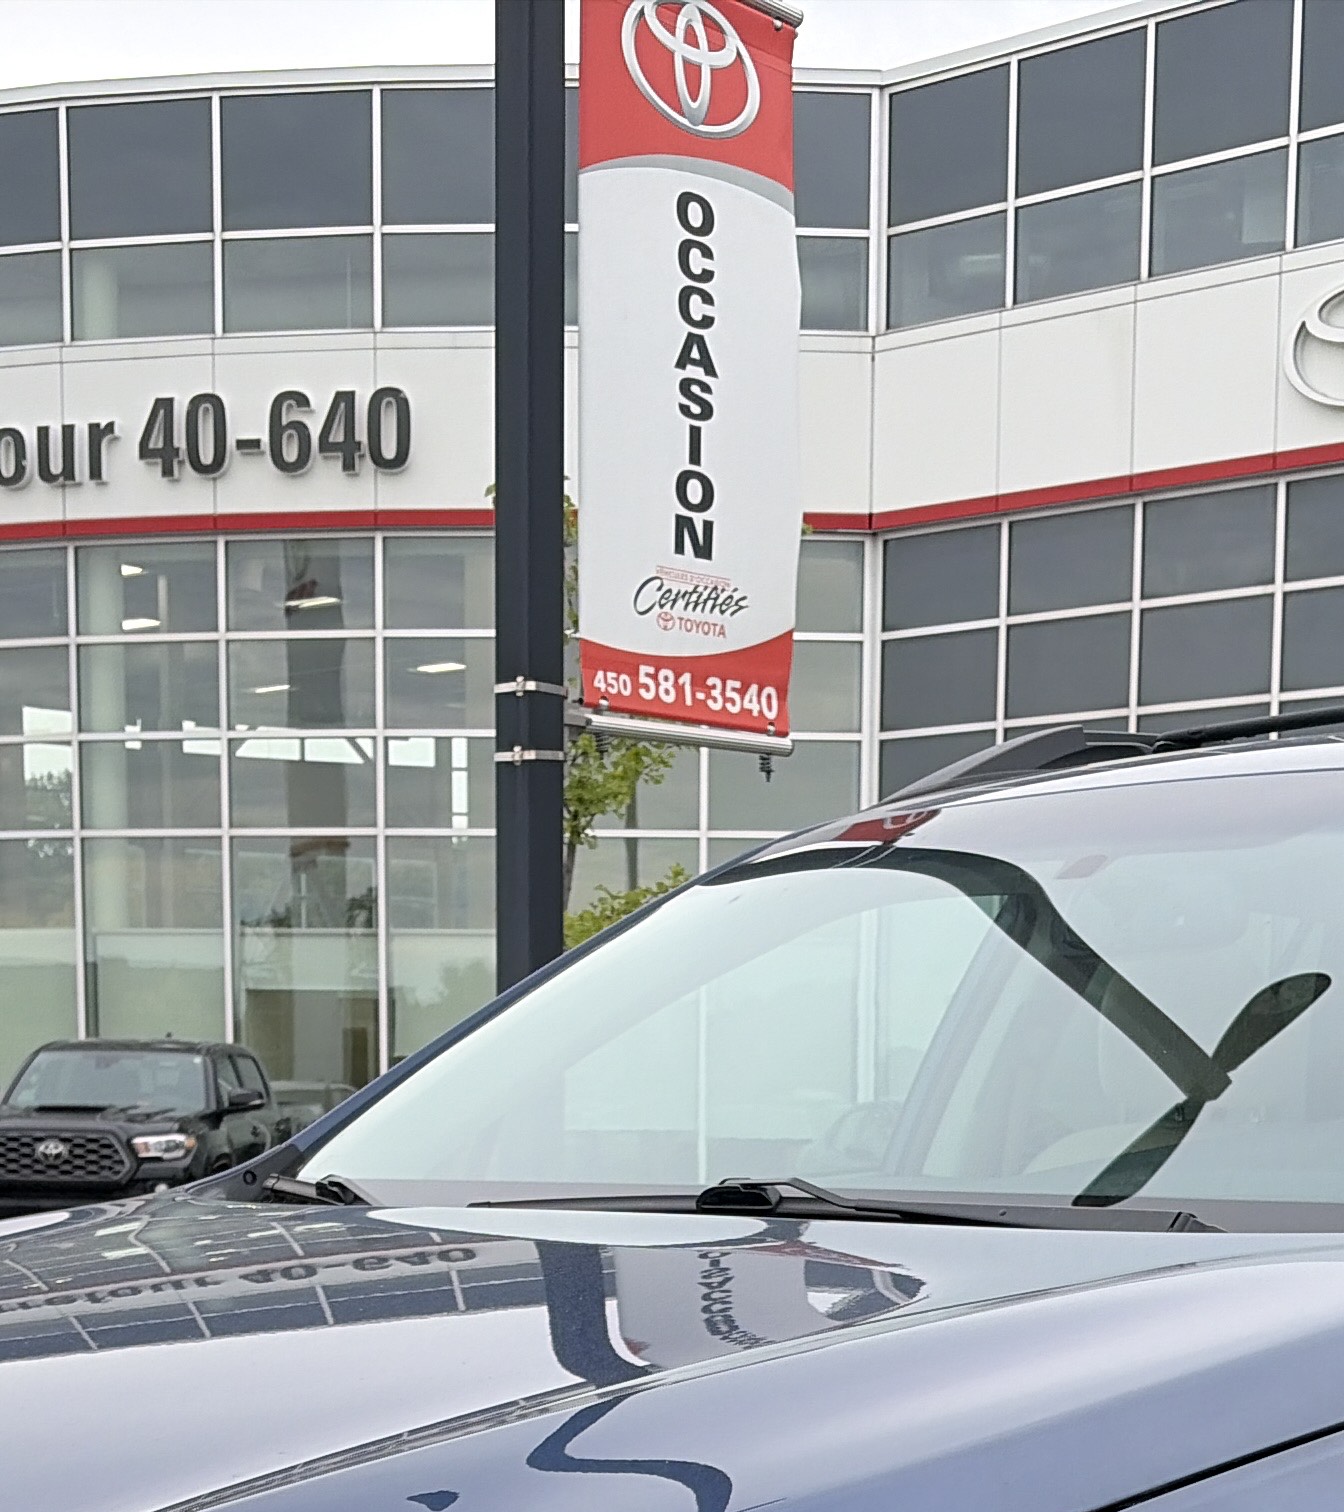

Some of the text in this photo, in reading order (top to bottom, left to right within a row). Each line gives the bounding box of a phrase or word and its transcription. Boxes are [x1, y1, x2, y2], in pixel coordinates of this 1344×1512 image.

[674, 190, 719, 562] OCCASION
[138, 386, 412, 478] 40-640
[633, 575, 749, 617] Certifiés
[677, 616, 727, 638] TOYOTA
[593, 664, 778, 720] 450 581-3540
